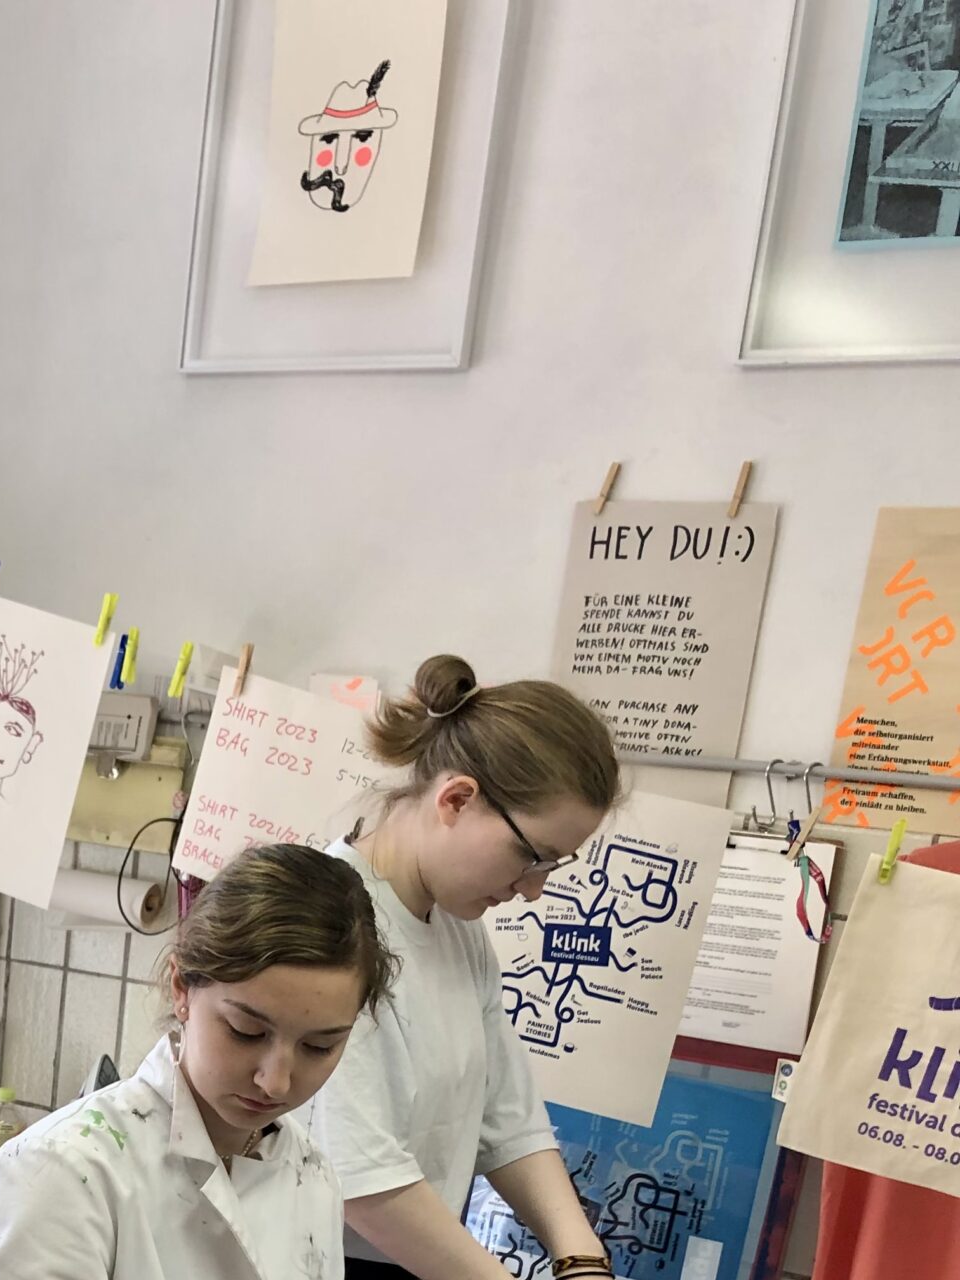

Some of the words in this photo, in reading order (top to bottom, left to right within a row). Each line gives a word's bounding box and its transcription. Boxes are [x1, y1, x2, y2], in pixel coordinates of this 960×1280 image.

[589, 525, 654, 561] HEY
[584, 593, 608, 607] FÜR
[614, 594, 640, 606] EINE
[647, 594, 692, 608] KLEINE
[583, 609, 622, 620] SPENDE
[627, 608, 670, 621] KANNST
[678, 611, 694, 621] DU
[578, 623, 602, 633] ALLE
[607, 623, 646, 634] DRUCKE
[651, 624, 677, 637] HIER
[682, 627, 703, 639] ER-
[576, 638, 625, 650] WERBEN!
[629, 639, 676, 651] OFTMALS
[683, 642, 709, 654] SIND
[574, 653, 593, 662] VON
[637, 653, 669, 665] MOTIV
[673, 656, 701, 666] NOCH
[572, 665, 602, 675] MEHR
[632, 665, 663, 676] FRAG
[667, 668, 694, 680] UNS!
[618, 700, 666, 713] PURCHASE
[673, 703, 699, 717] ANY
[222, 694, 269, 728] SHIRT
[274, 716, 318, 744] 2023
[623, 717, 630, 725] A
[633, 717, 659, 729] TINY
[663, 719, 698, 732] DONA-
[856, 717, 898, 727] Menschen,
[656, 732, 692, 744] OFTEN
[868, 730, 934, 742] selbstorganisiert
[216, 727, 251, 757] BAG
[265, 746, 313, 776] 2023
[662, 746, 681, 756] ASK
[851, 741, 900, 751] miteinander
[868, 753, 952, 768] Erfahrungswerkstatt,
[842, 787, 878, 797] Freiraum
[880, 791, 916, 801] schaffen,
[840, 798, 852, 806] der
[855, 801, 882, 809] einlädt
[896, 803, 927, 814] bleiben.
[197, 794, 238, 821] SHIRT
[248, 812, 300, 844] 2021/22
[193, 818, 222, 842] BAG
[551, 930, 601, 953] klink
[550, 950, 575, 960] festival
[575, 953, 599, 962] dessau
[525, 1027, 552, 1039] STORIES
[527, 1020, 555, 1032] PAINTED
[867, 1092, 948, 1132] festival
[857, 1121, 906, 1149] 06.08.
